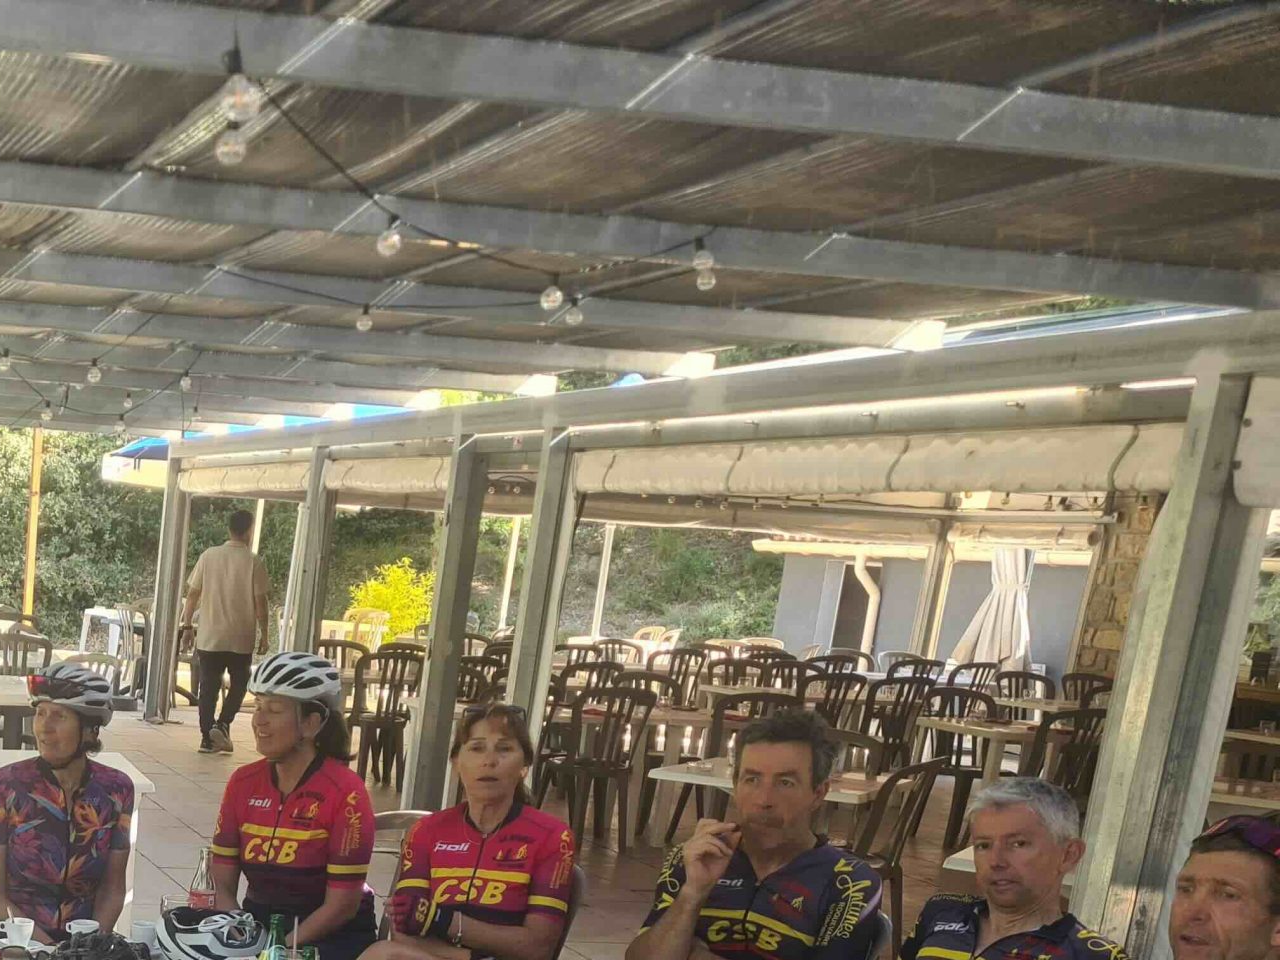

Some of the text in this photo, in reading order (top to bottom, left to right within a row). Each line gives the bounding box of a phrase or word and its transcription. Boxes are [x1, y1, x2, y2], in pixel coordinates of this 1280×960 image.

[244, 838, 298, 864] CSB
[434, 841, 471, 853] poli
[434, 879, 507, 905] CSB
[707, 920, 782, 951] CSB
